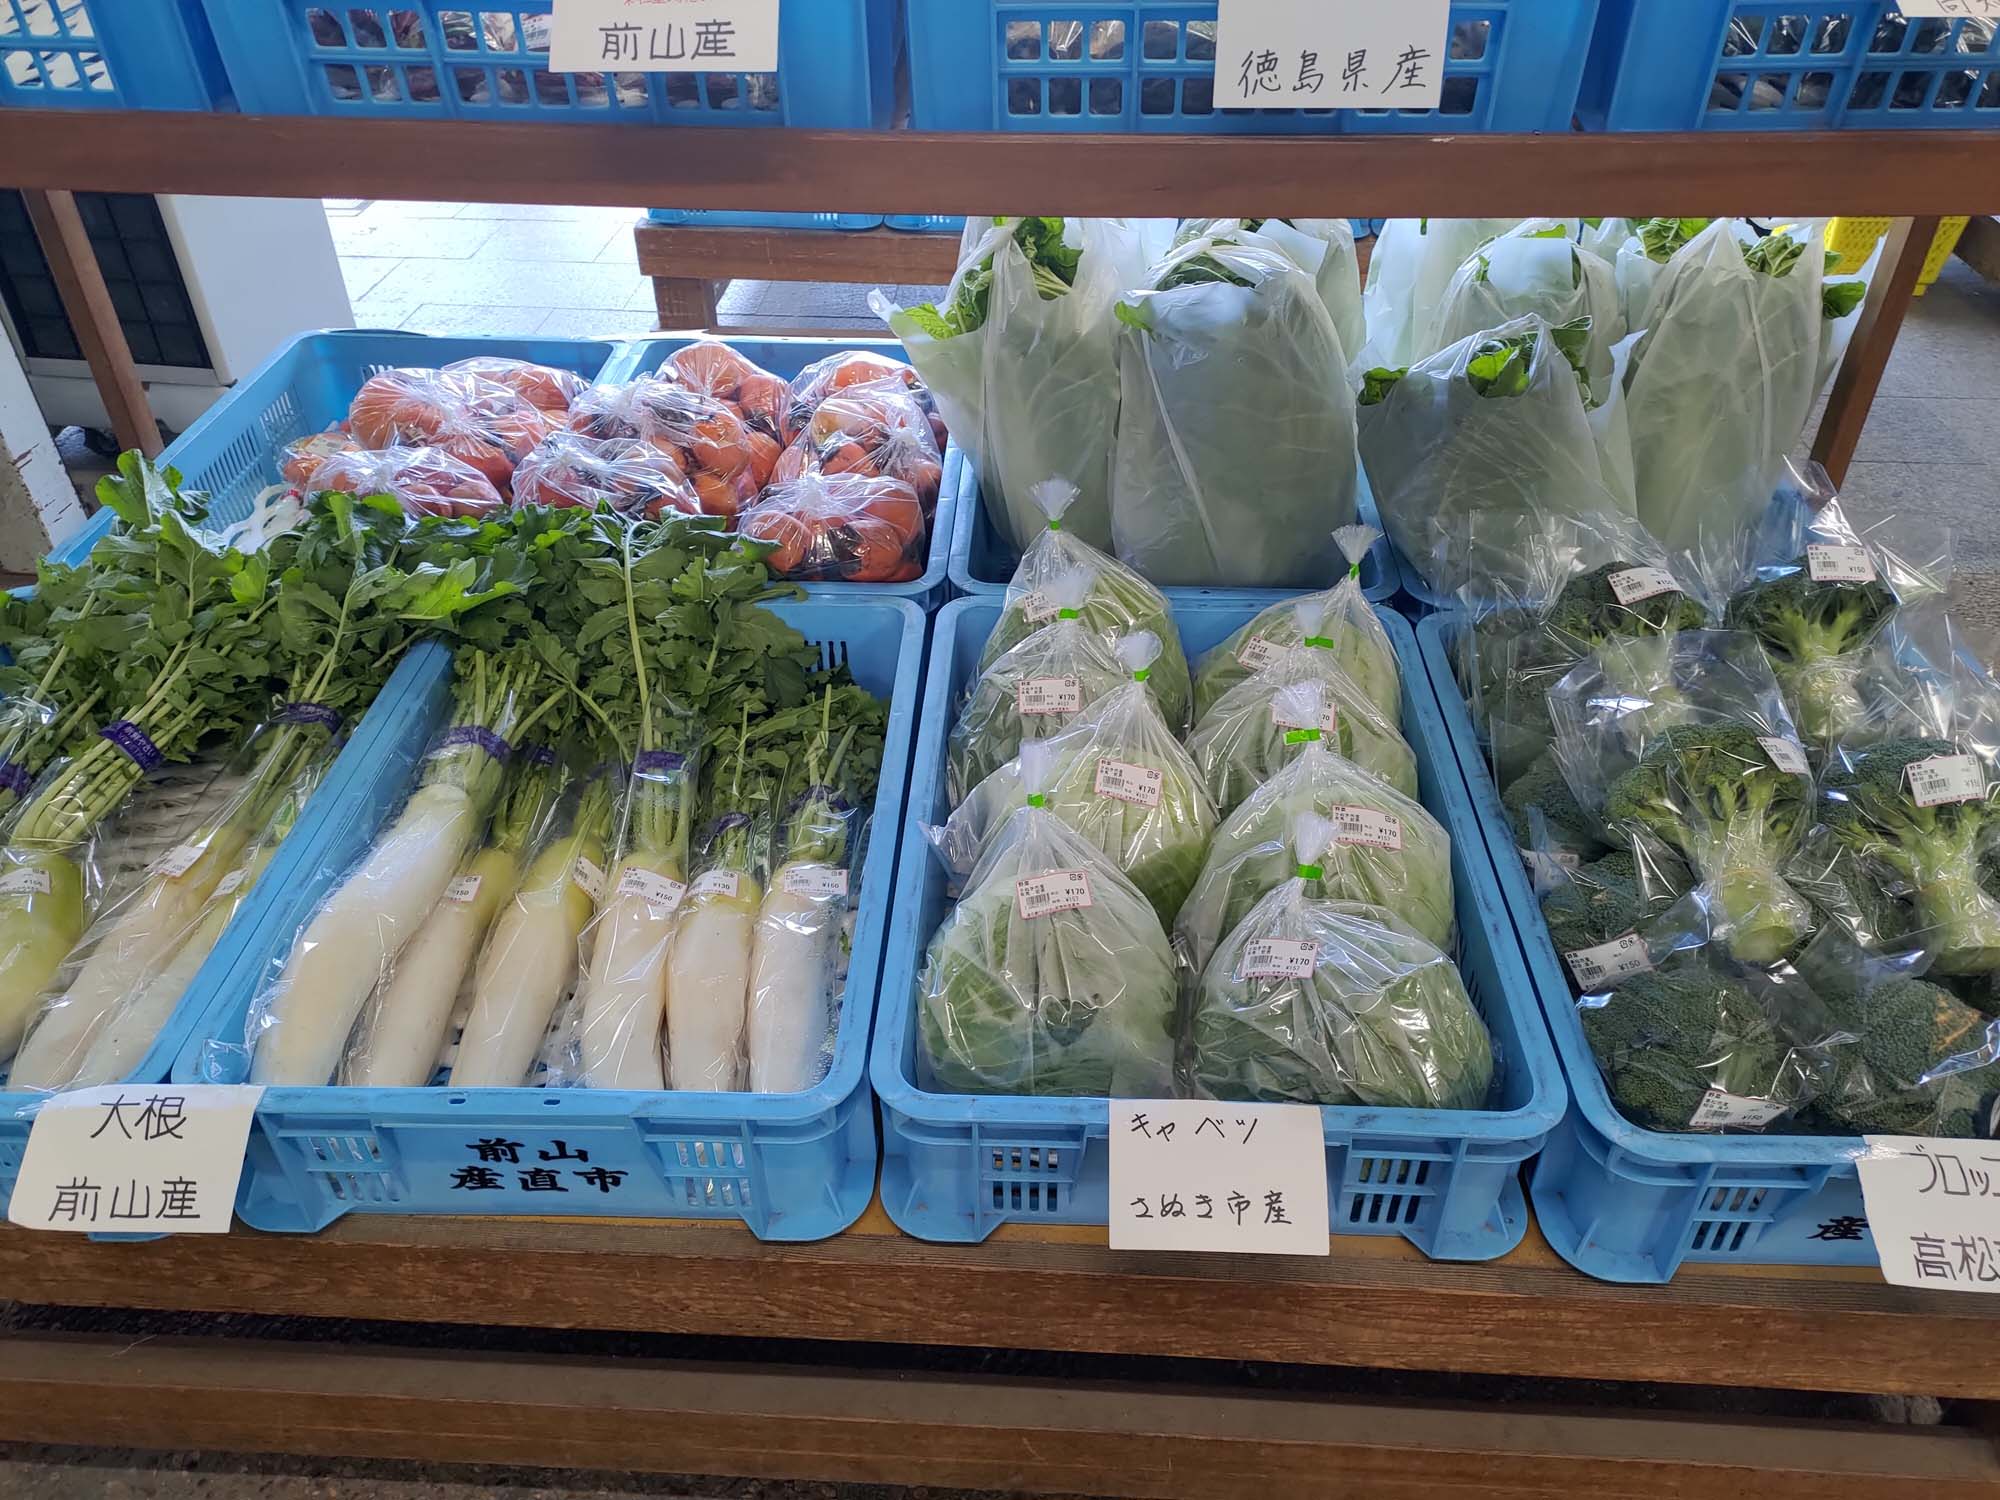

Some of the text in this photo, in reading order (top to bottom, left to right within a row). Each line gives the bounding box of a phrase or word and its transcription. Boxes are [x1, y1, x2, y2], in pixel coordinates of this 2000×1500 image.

[598, 19, 736, 61] 前山産
[1238, 44, 1431, 98] 徳島県産
[1139, 784, 1156, 795] ¥170
[1378, 827, 1397, 838] ¥170
[655, 890, 673, 902] ¥150
[1065, 888, 1085, 896] ¥170
[1289, 957, 1310, 966] ¥170
[1617, 959, 1641, 972] ¥150
[90, 1094, 187, 1140] 大根
[1131, 1113, 1258, 1145] キャベツ
[465, 1137, 590, 1164] 前山
[449, 1165, 630, 1194] 産直市
[48, 1176, 201, 1222] 前山産
[1130, 1190, 1293, 1226] さぬき市産
[1807, 1216, 1870, 1241] 産
[1910, 1232, 2000, 1282] 高松
